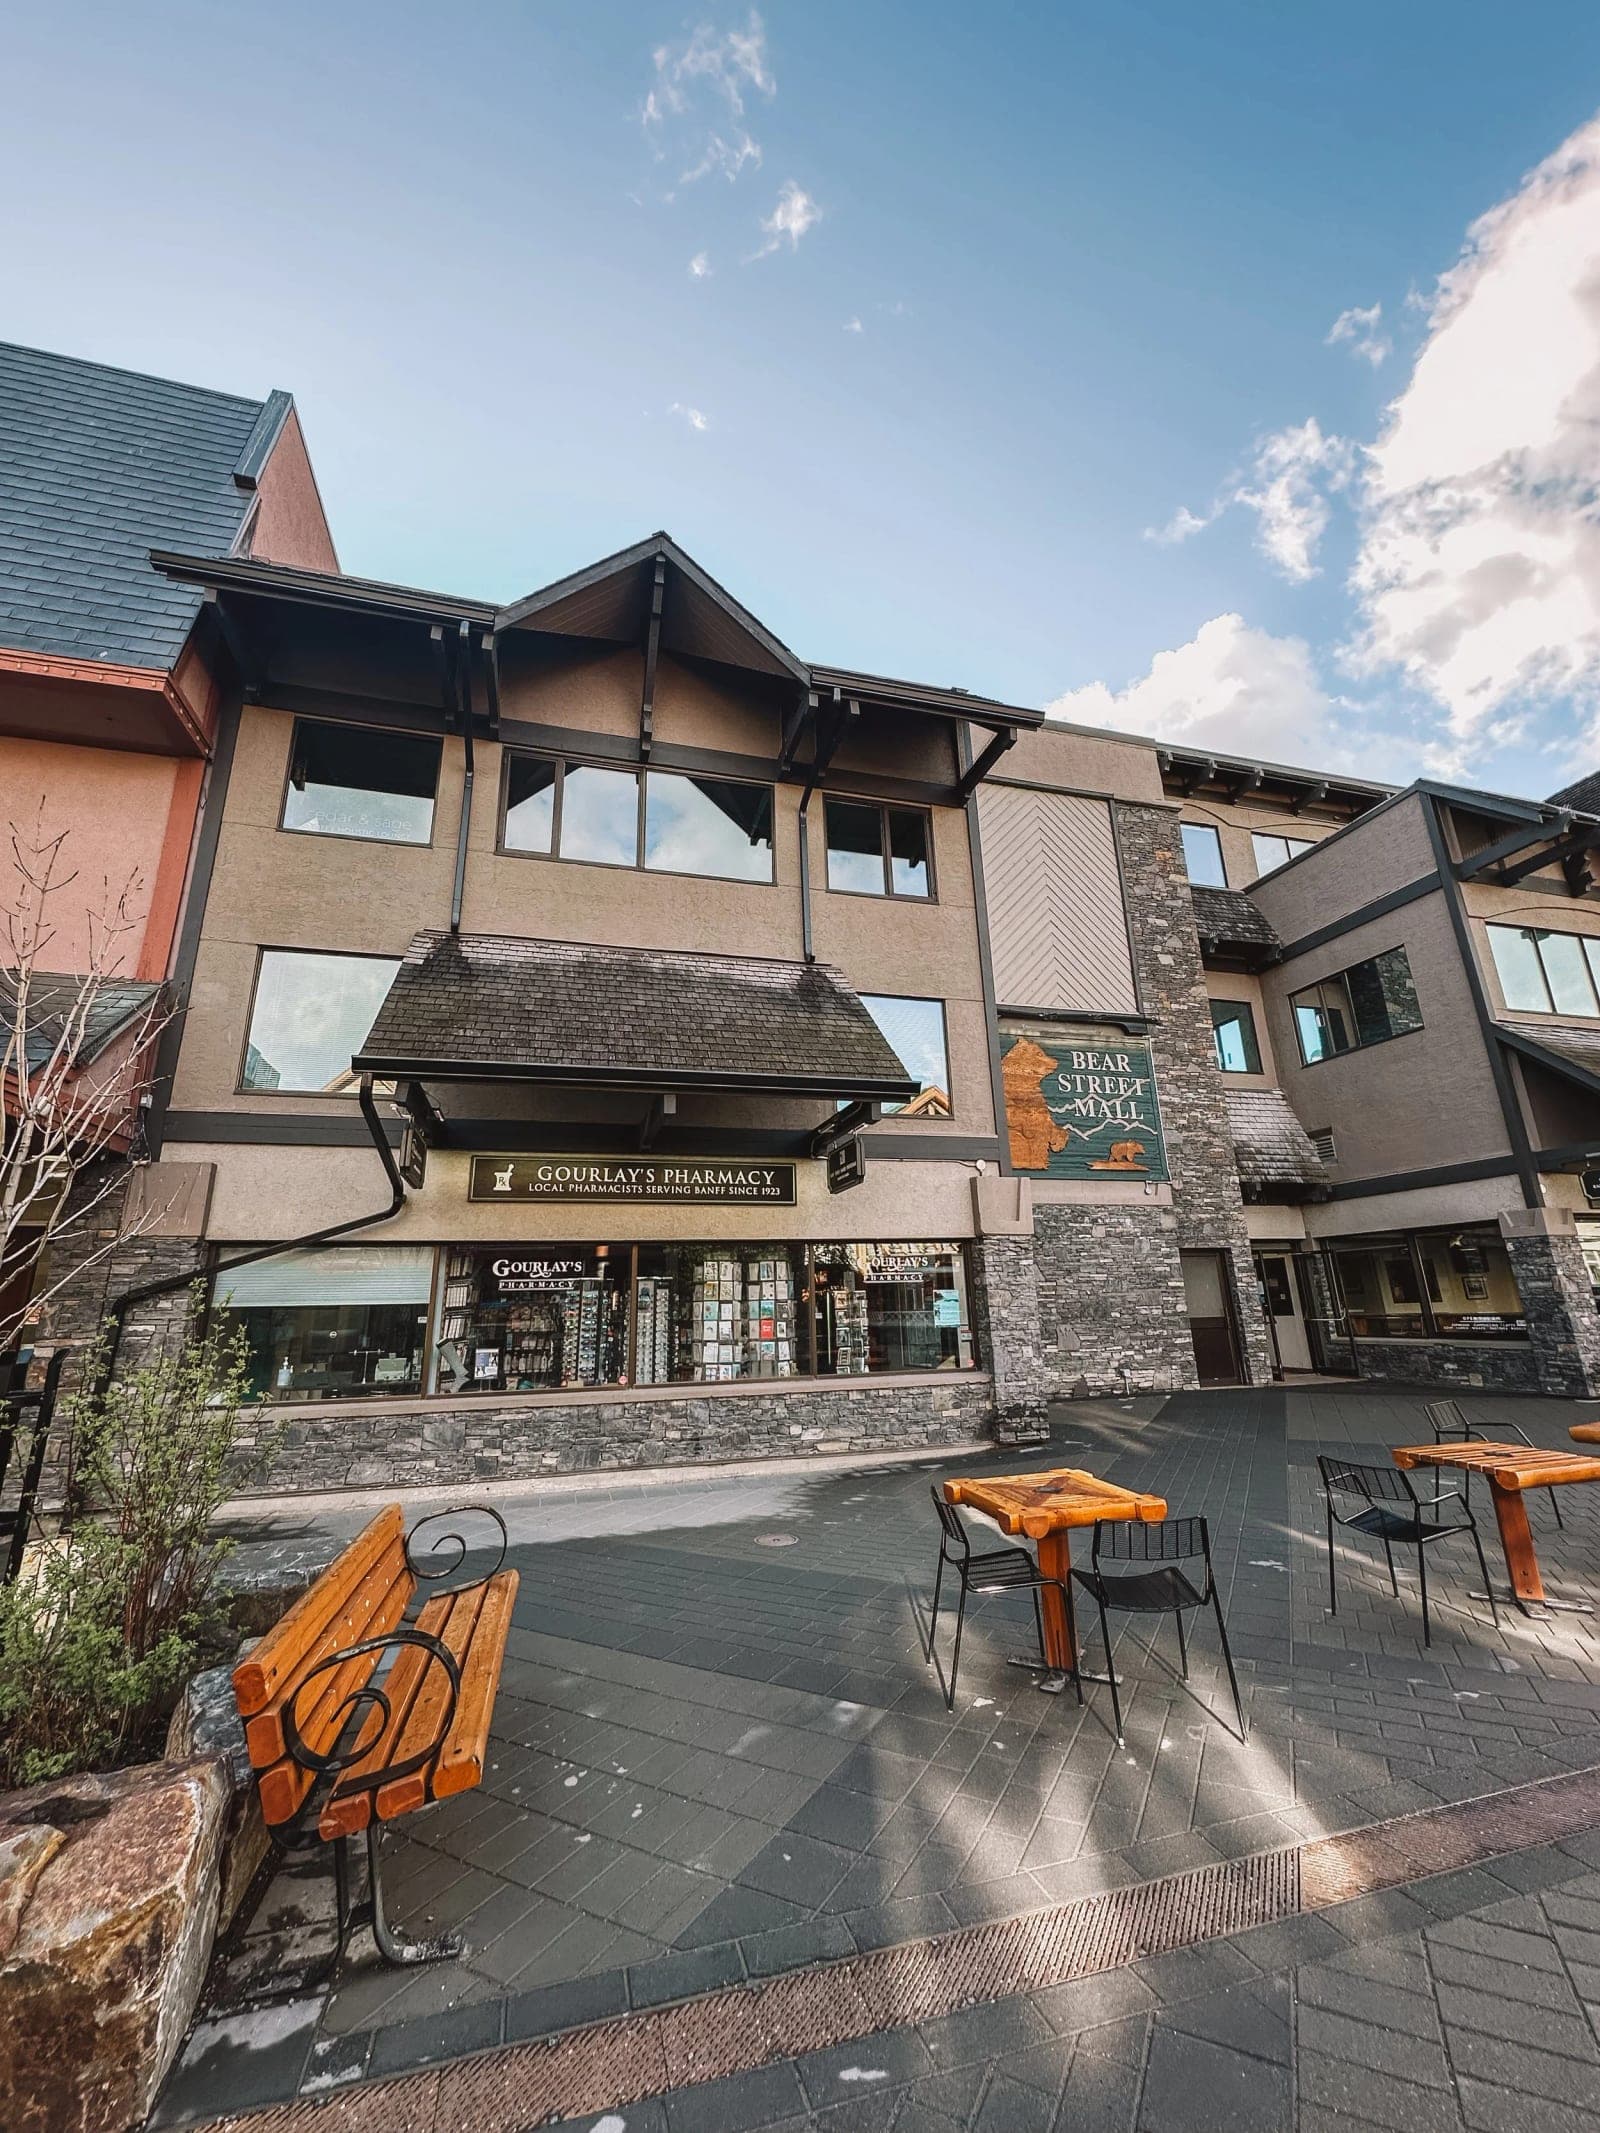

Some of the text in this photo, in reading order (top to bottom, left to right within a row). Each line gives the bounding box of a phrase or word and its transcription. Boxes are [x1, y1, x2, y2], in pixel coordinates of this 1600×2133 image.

[1071, 1051, 1132, 1073] BEAR
[1057, 1073, 1146, 1096] STREET
[1074, 1098, 1144, 1120] MALL
[537, 1165, 775, 1185] GOURLAY'S PHARMACY
[528, 1183, 780, 1196] LOCAL PHARMACISTS SERVING BANFF SINCE 1923
[492, 1259, 582, 1278] GOURLAY'S
